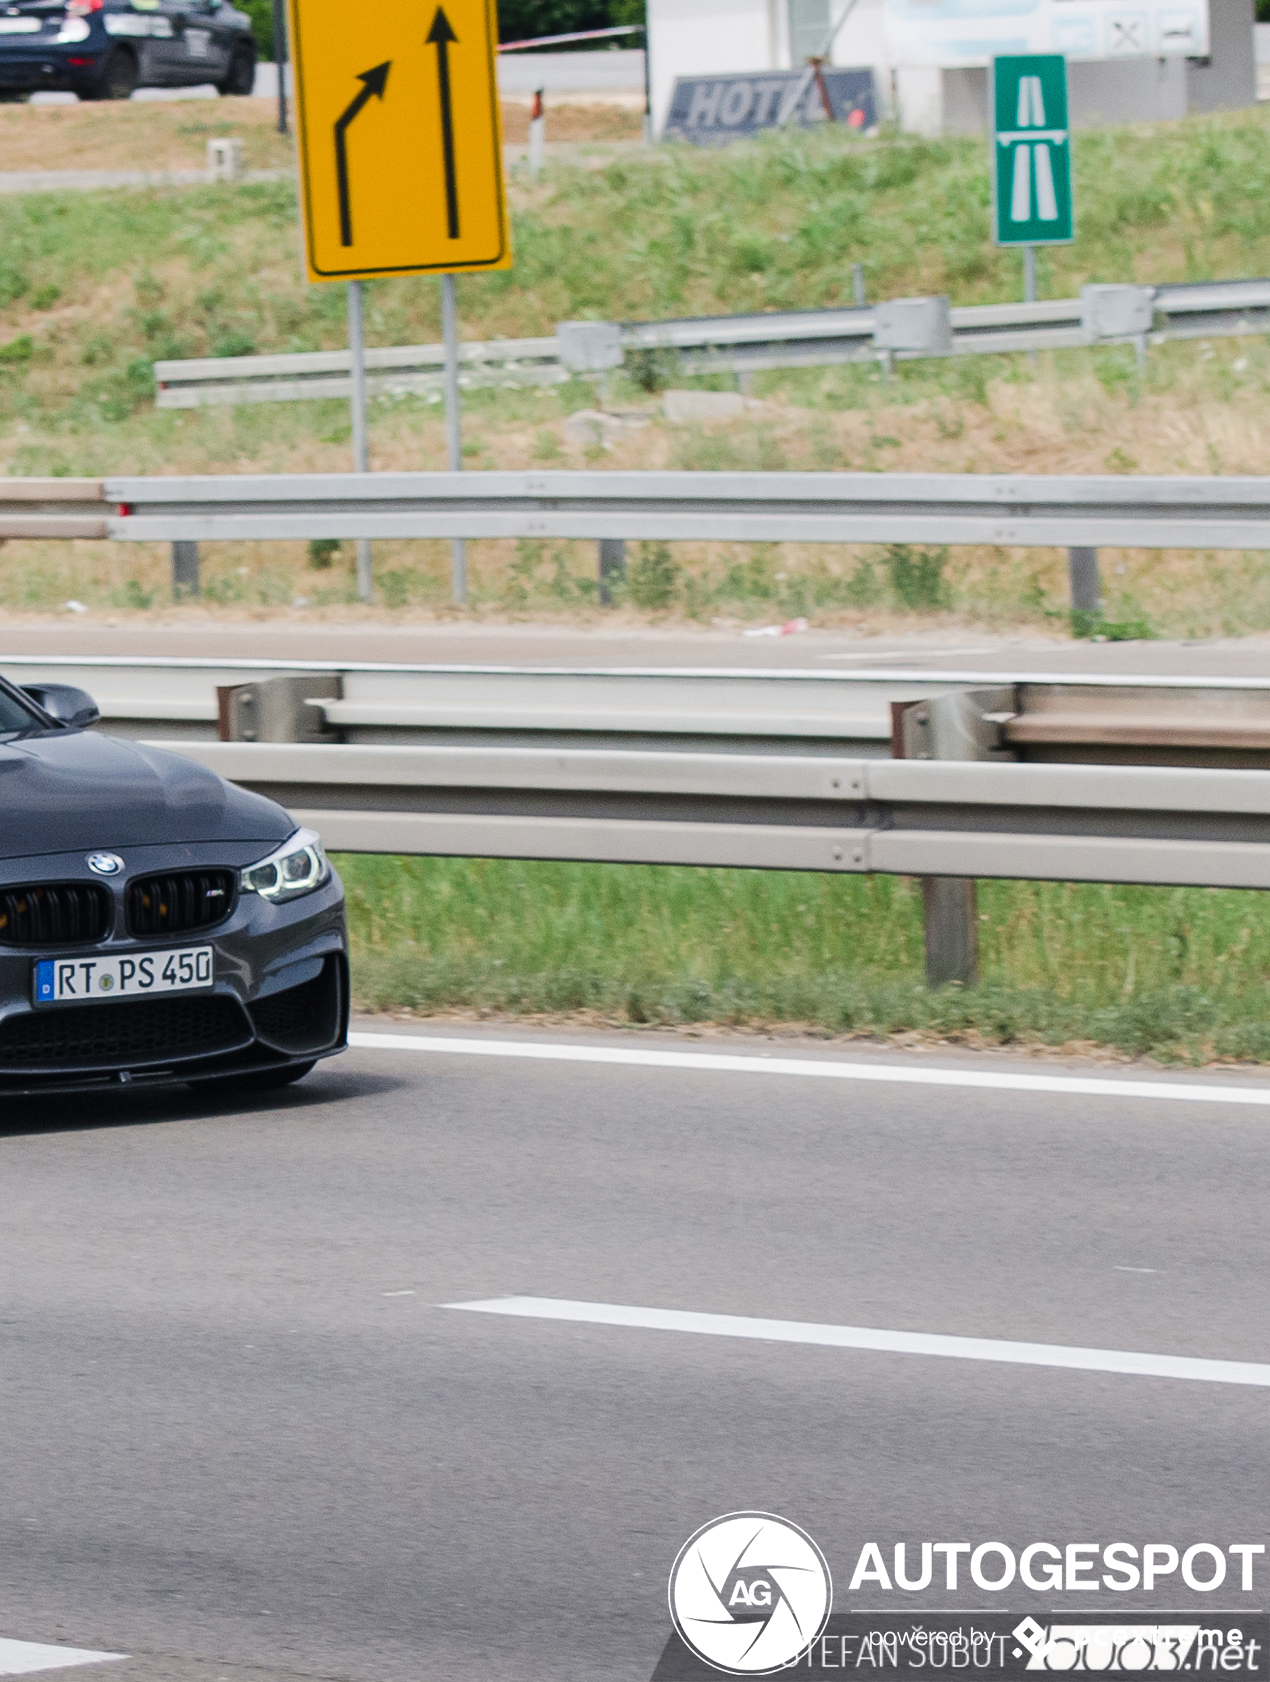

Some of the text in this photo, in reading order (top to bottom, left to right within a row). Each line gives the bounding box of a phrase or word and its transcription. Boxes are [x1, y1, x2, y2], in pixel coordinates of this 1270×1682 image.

[59, 951, 210, 995] RT PS 450
